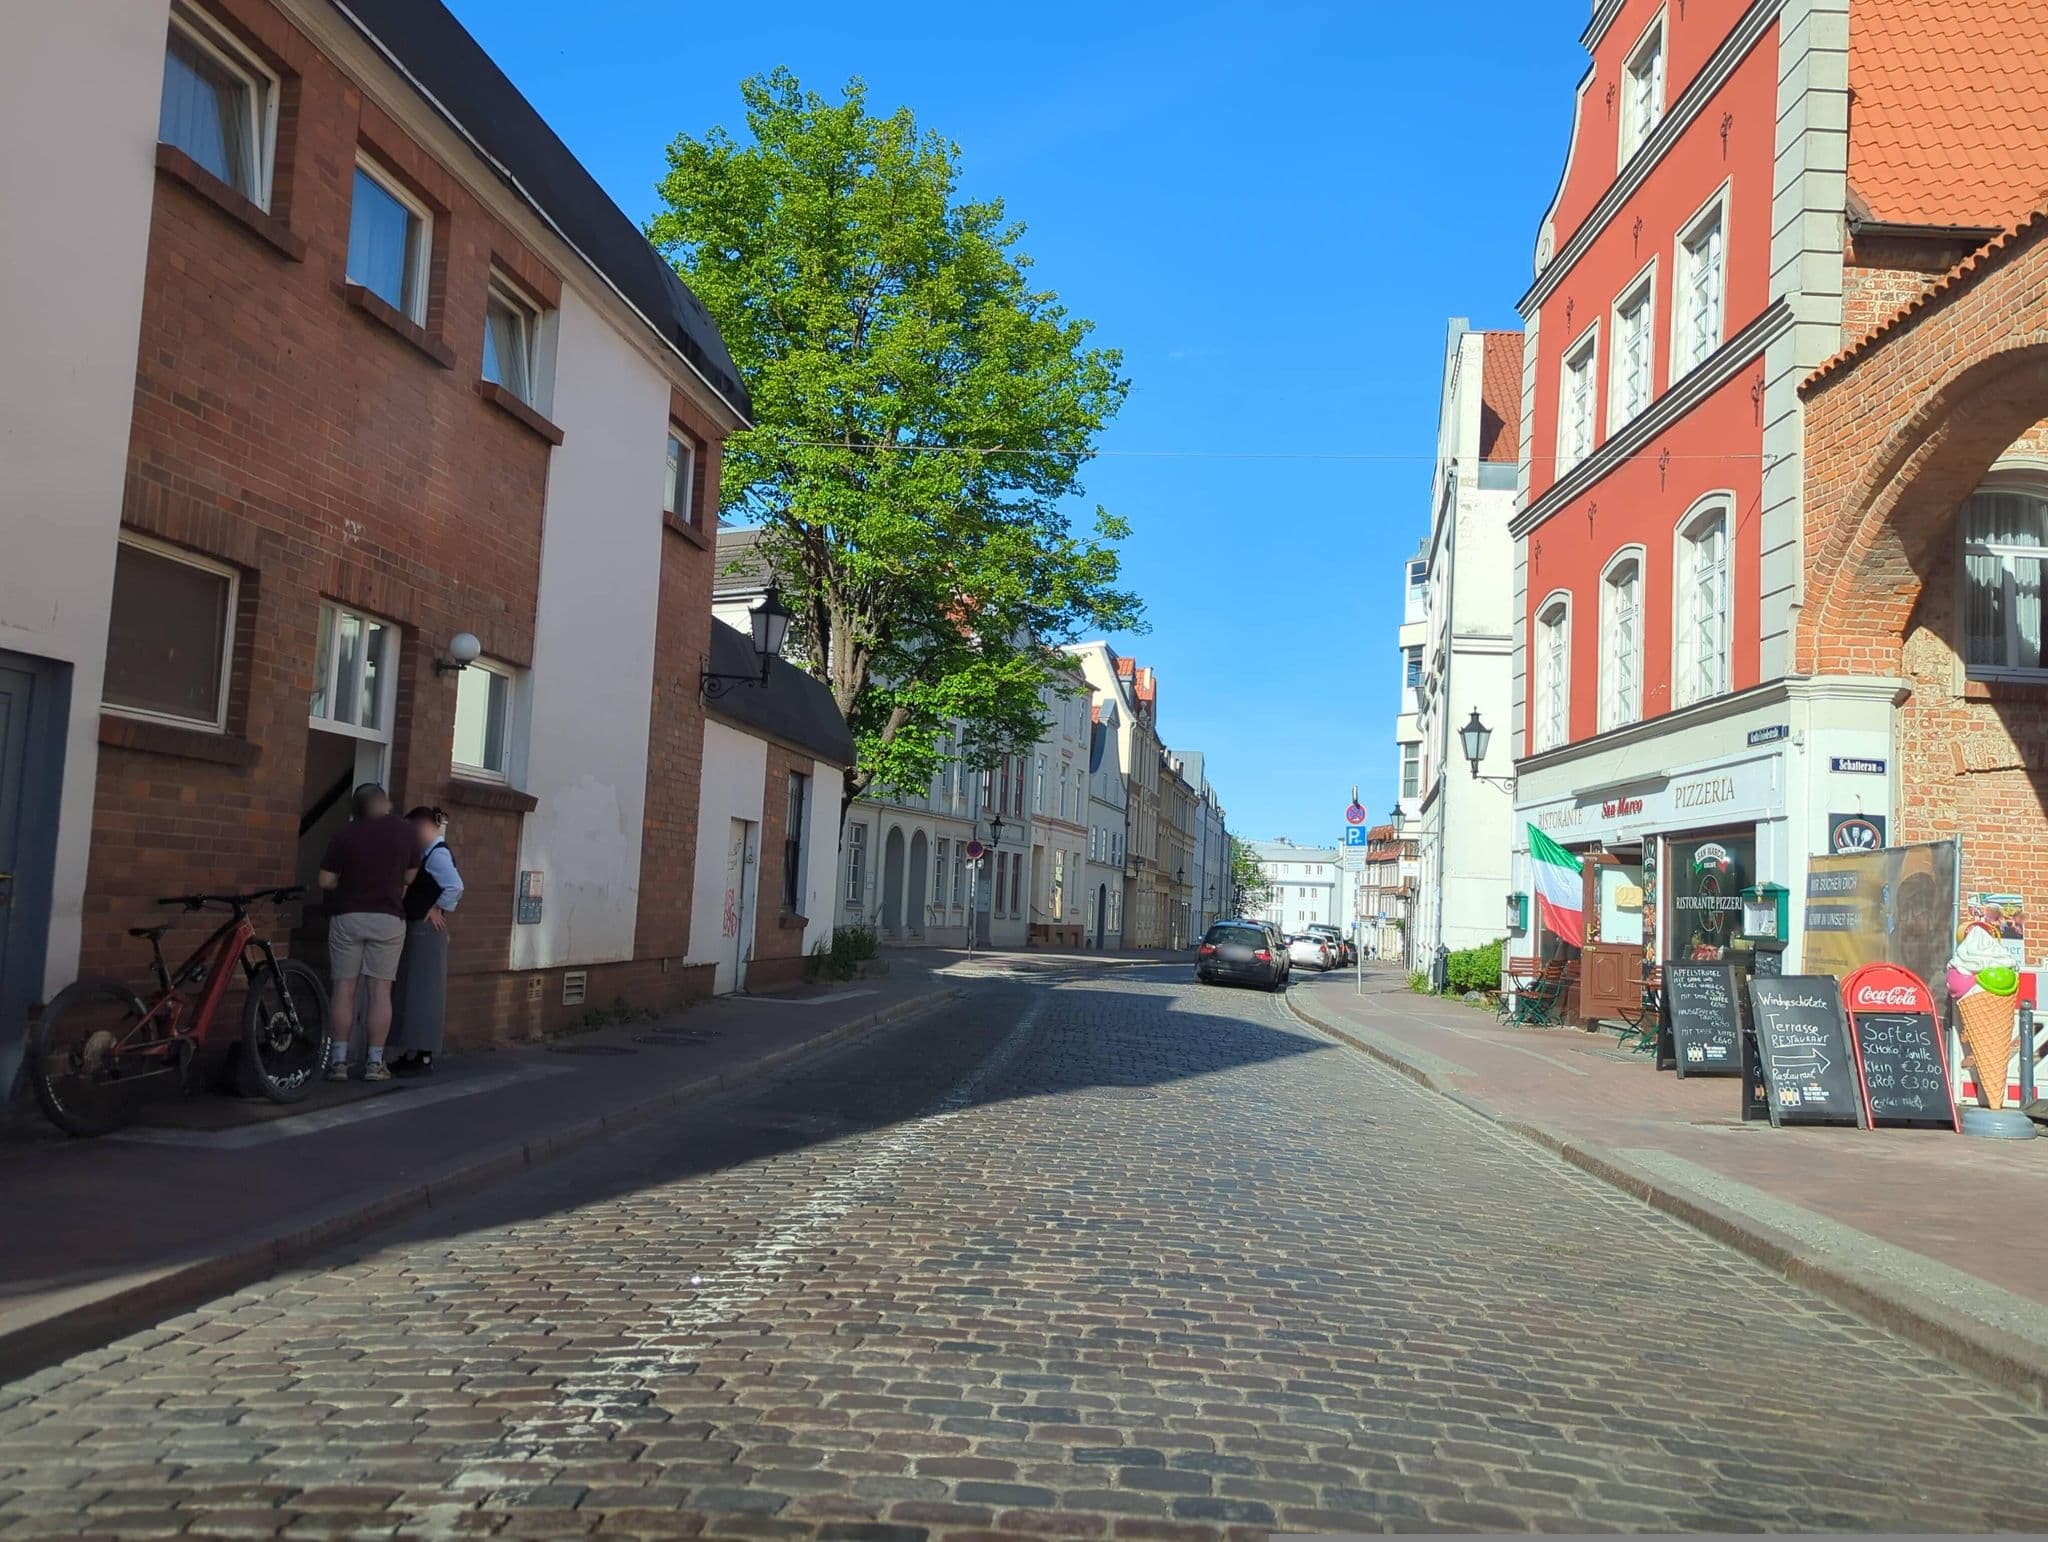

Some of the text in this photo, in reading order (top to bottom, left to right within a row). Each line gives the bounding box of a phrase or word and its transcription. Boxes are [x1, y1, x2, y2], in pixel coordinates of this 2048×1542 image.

[1675, 776, 1736, 810] PIZZERIA
[1538, 808, 1583, 831] RISTORANTE
[1602, 797, 1643, 820] San Marco
[1348, 828, 1360, 844] P
[1676, 896, 1742, 910] RISTORANTE PIZZERI
[1858, 985, 1918, 1006] Coca-Cola
[1765, 1013, 1819, 1036] Terrasse
[1864, 1022, 1931, 1046] Softeis
[1864, 1060, 1893, 1074] Klein
